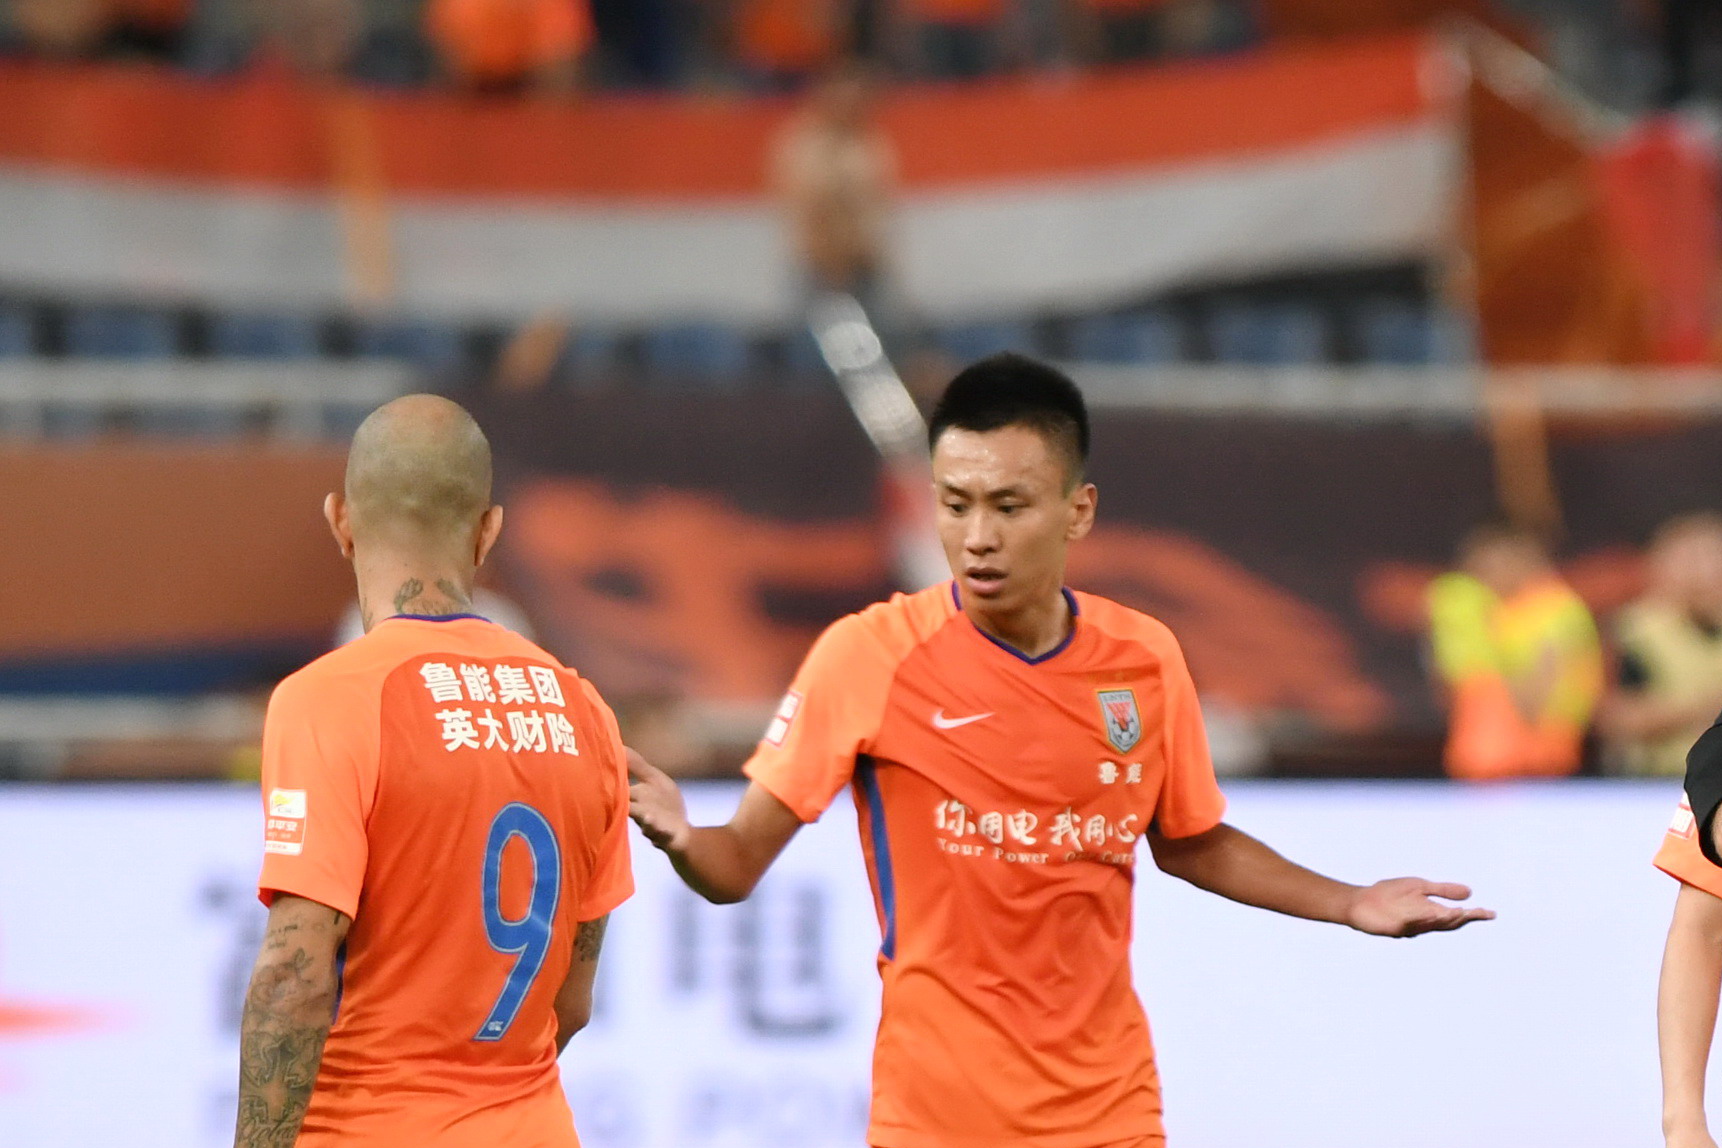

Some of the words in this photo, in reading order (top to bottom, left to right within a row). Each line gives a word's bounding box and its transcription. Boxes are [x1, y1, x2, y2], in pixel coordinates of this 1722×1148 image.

[419, 662, 566, 707] 鲁能集团
[435, 707, 579, 756] 英大财险
[937, 837, 985, 857] Your
[994, 847, 1050, 864] Power
[472, 801, 563, 1042] 9
